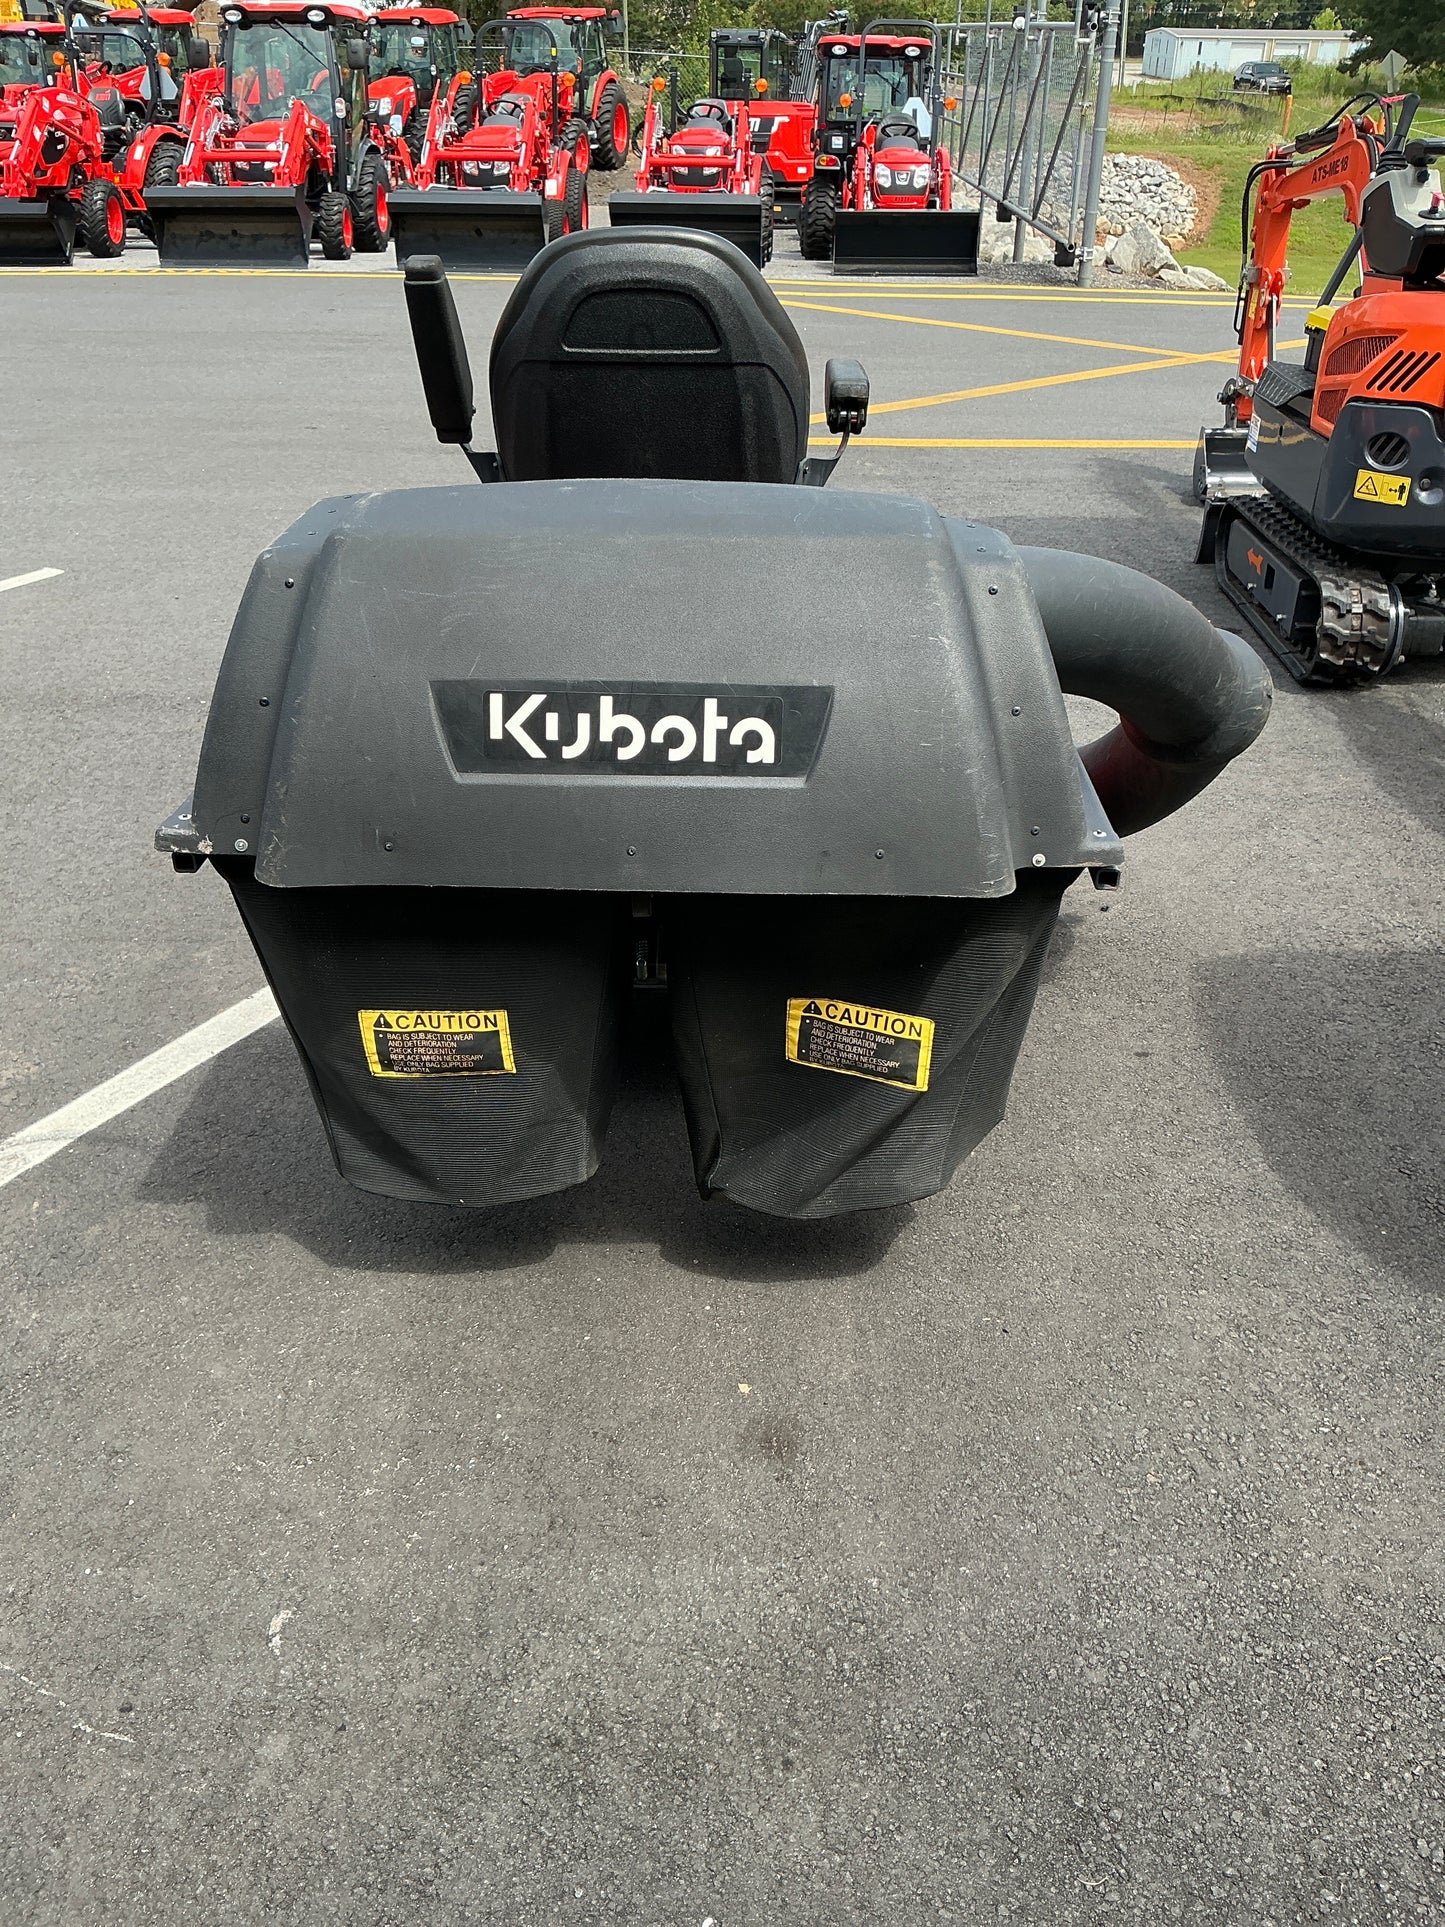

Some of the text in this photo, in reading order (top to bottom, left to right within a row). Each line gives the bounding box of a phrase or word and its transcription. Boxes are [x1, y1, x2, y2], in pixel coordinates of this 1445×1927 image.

[489, 692, 776, 764] Kubota
[395, 1014, 498, 1029] CAUTION
[825, 1003, 922, 1038] CAUTION
[387, 1032, 474, 1041] BAG IS SUBJECT TO WEAR
[811, 1027, 825, 1037] AND
[813, 1020, 895, 1046] BAG IS SUBJECT TO WEAR
[810, 1036, 833, 1048] CHECK
[809, 1044, 838, 1057] REPLACE
[838, 1050, 859, 1061] WHEN
[809, 1050, 823, 1058] USE
[823, 1053, 841, 1063] ONLY
